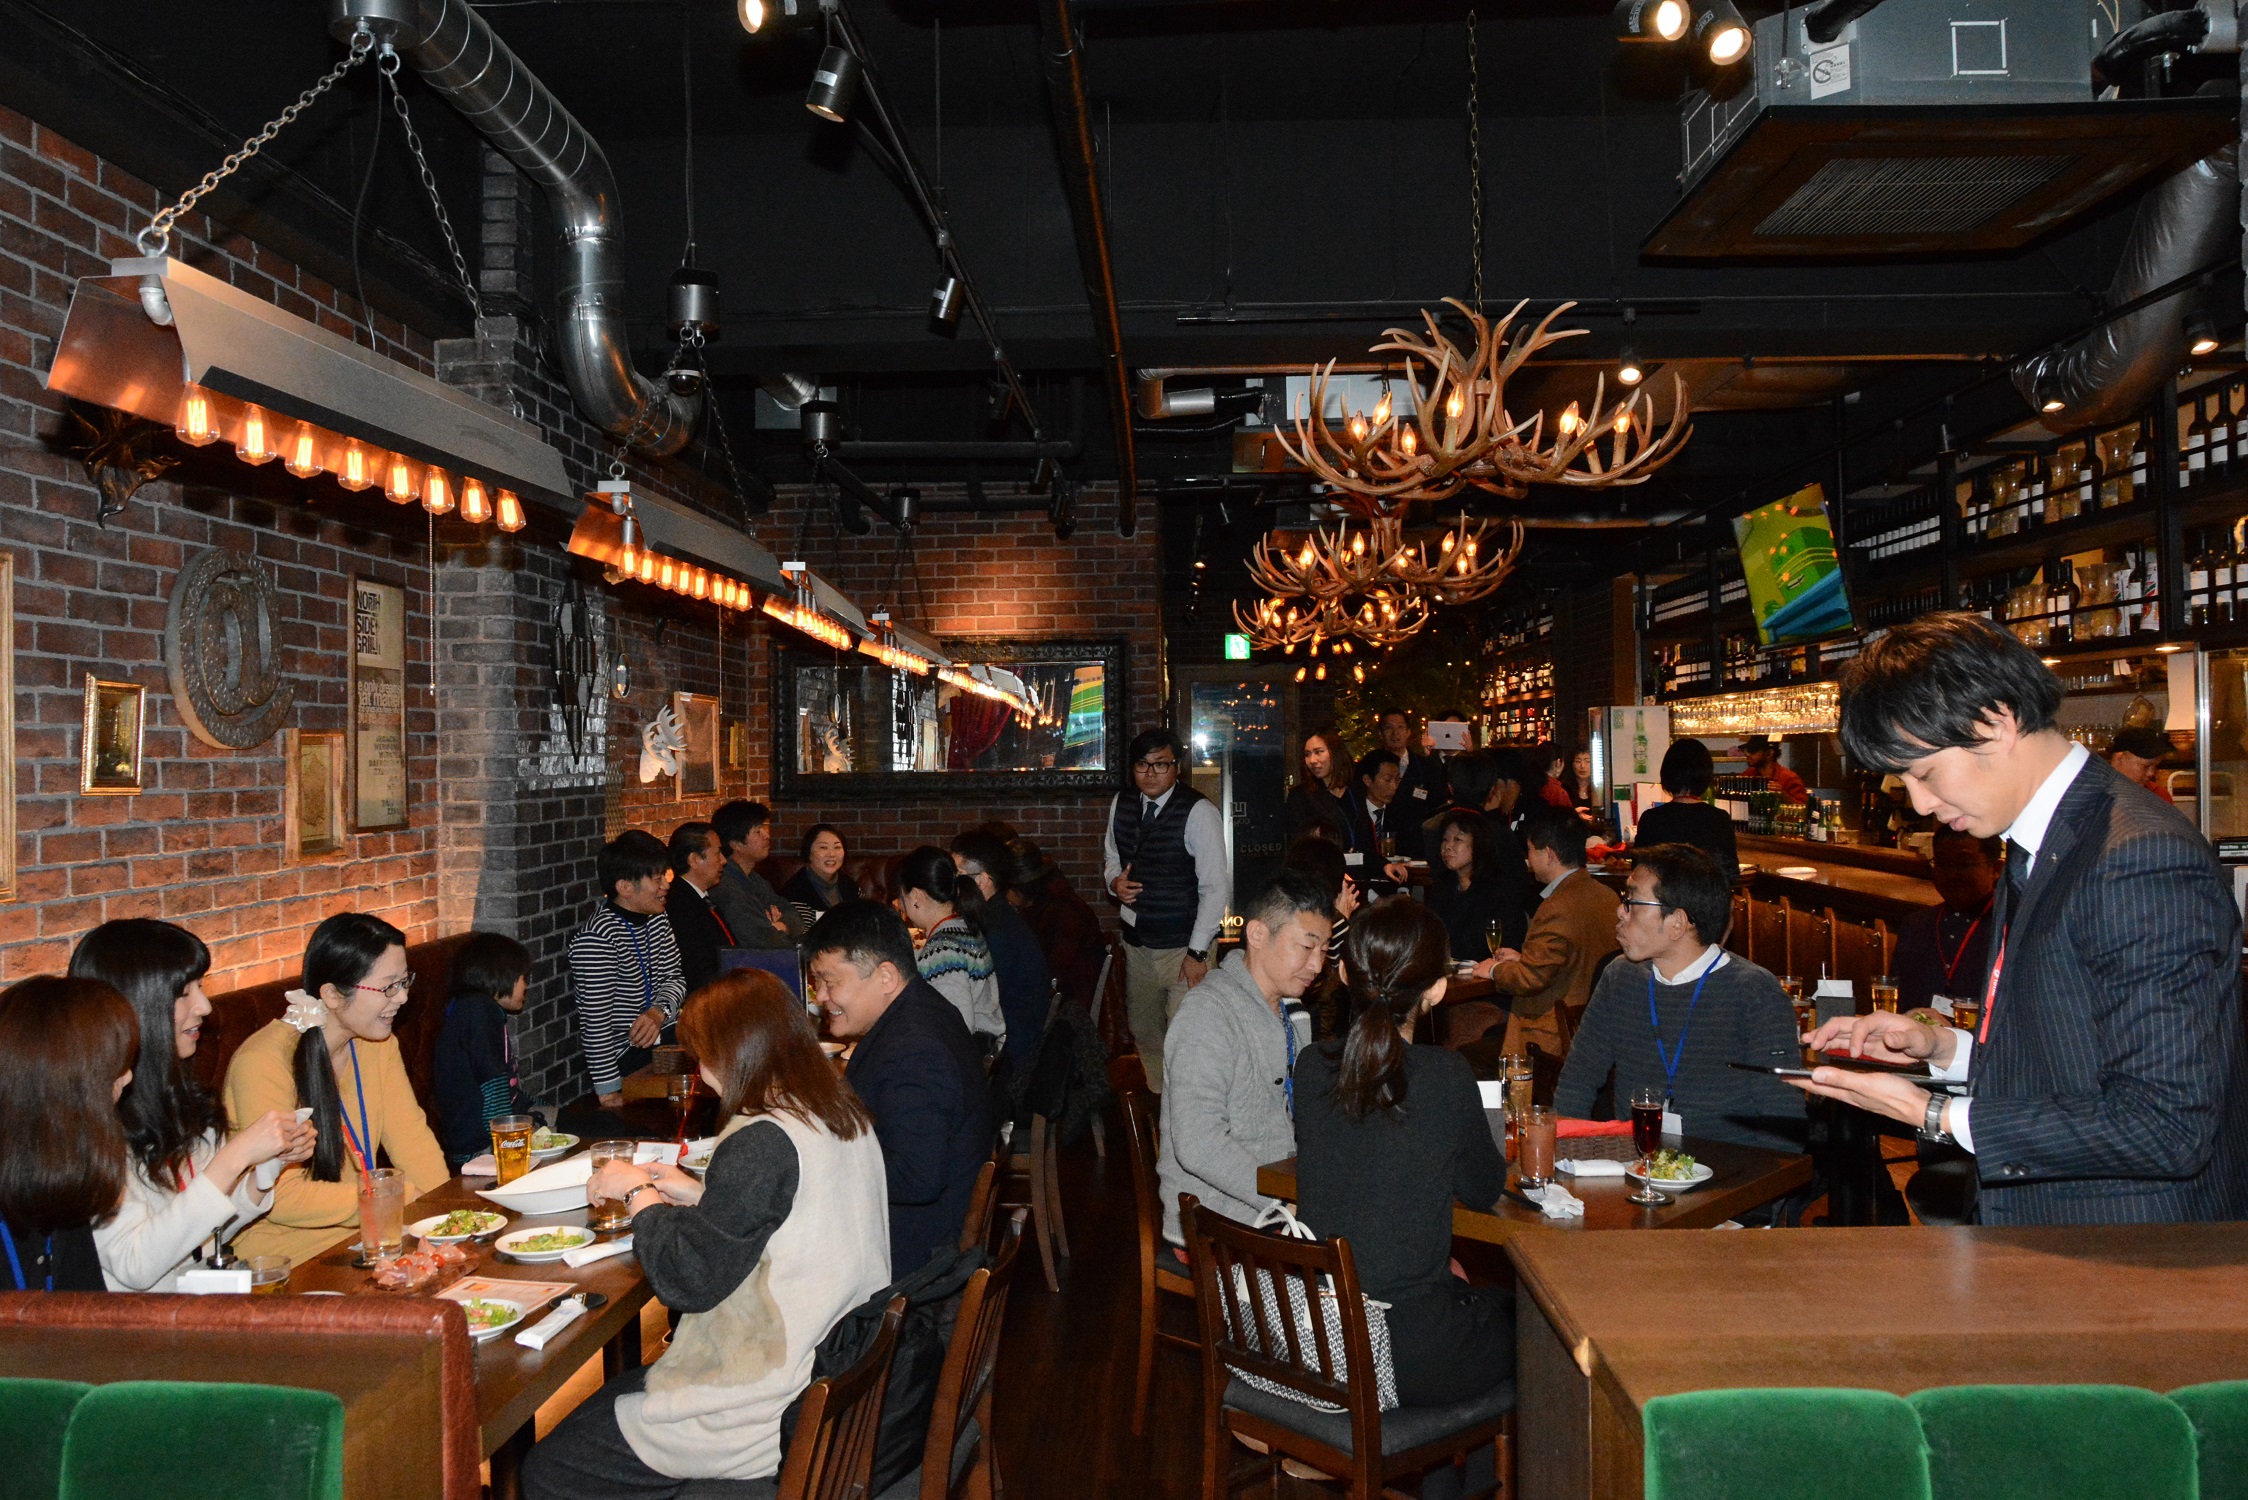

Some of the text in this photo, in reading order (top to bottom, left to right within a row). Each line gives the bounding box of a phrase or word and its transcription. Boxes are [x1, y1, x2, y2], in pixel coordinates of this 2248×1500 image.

[357, 590, 381, 612] NORTH
[357, 615, 376, 636] SIDE
[1241, 843, 1282, 853] CLOSED
[501, 1138, 525, 1149] Coca-Cola
